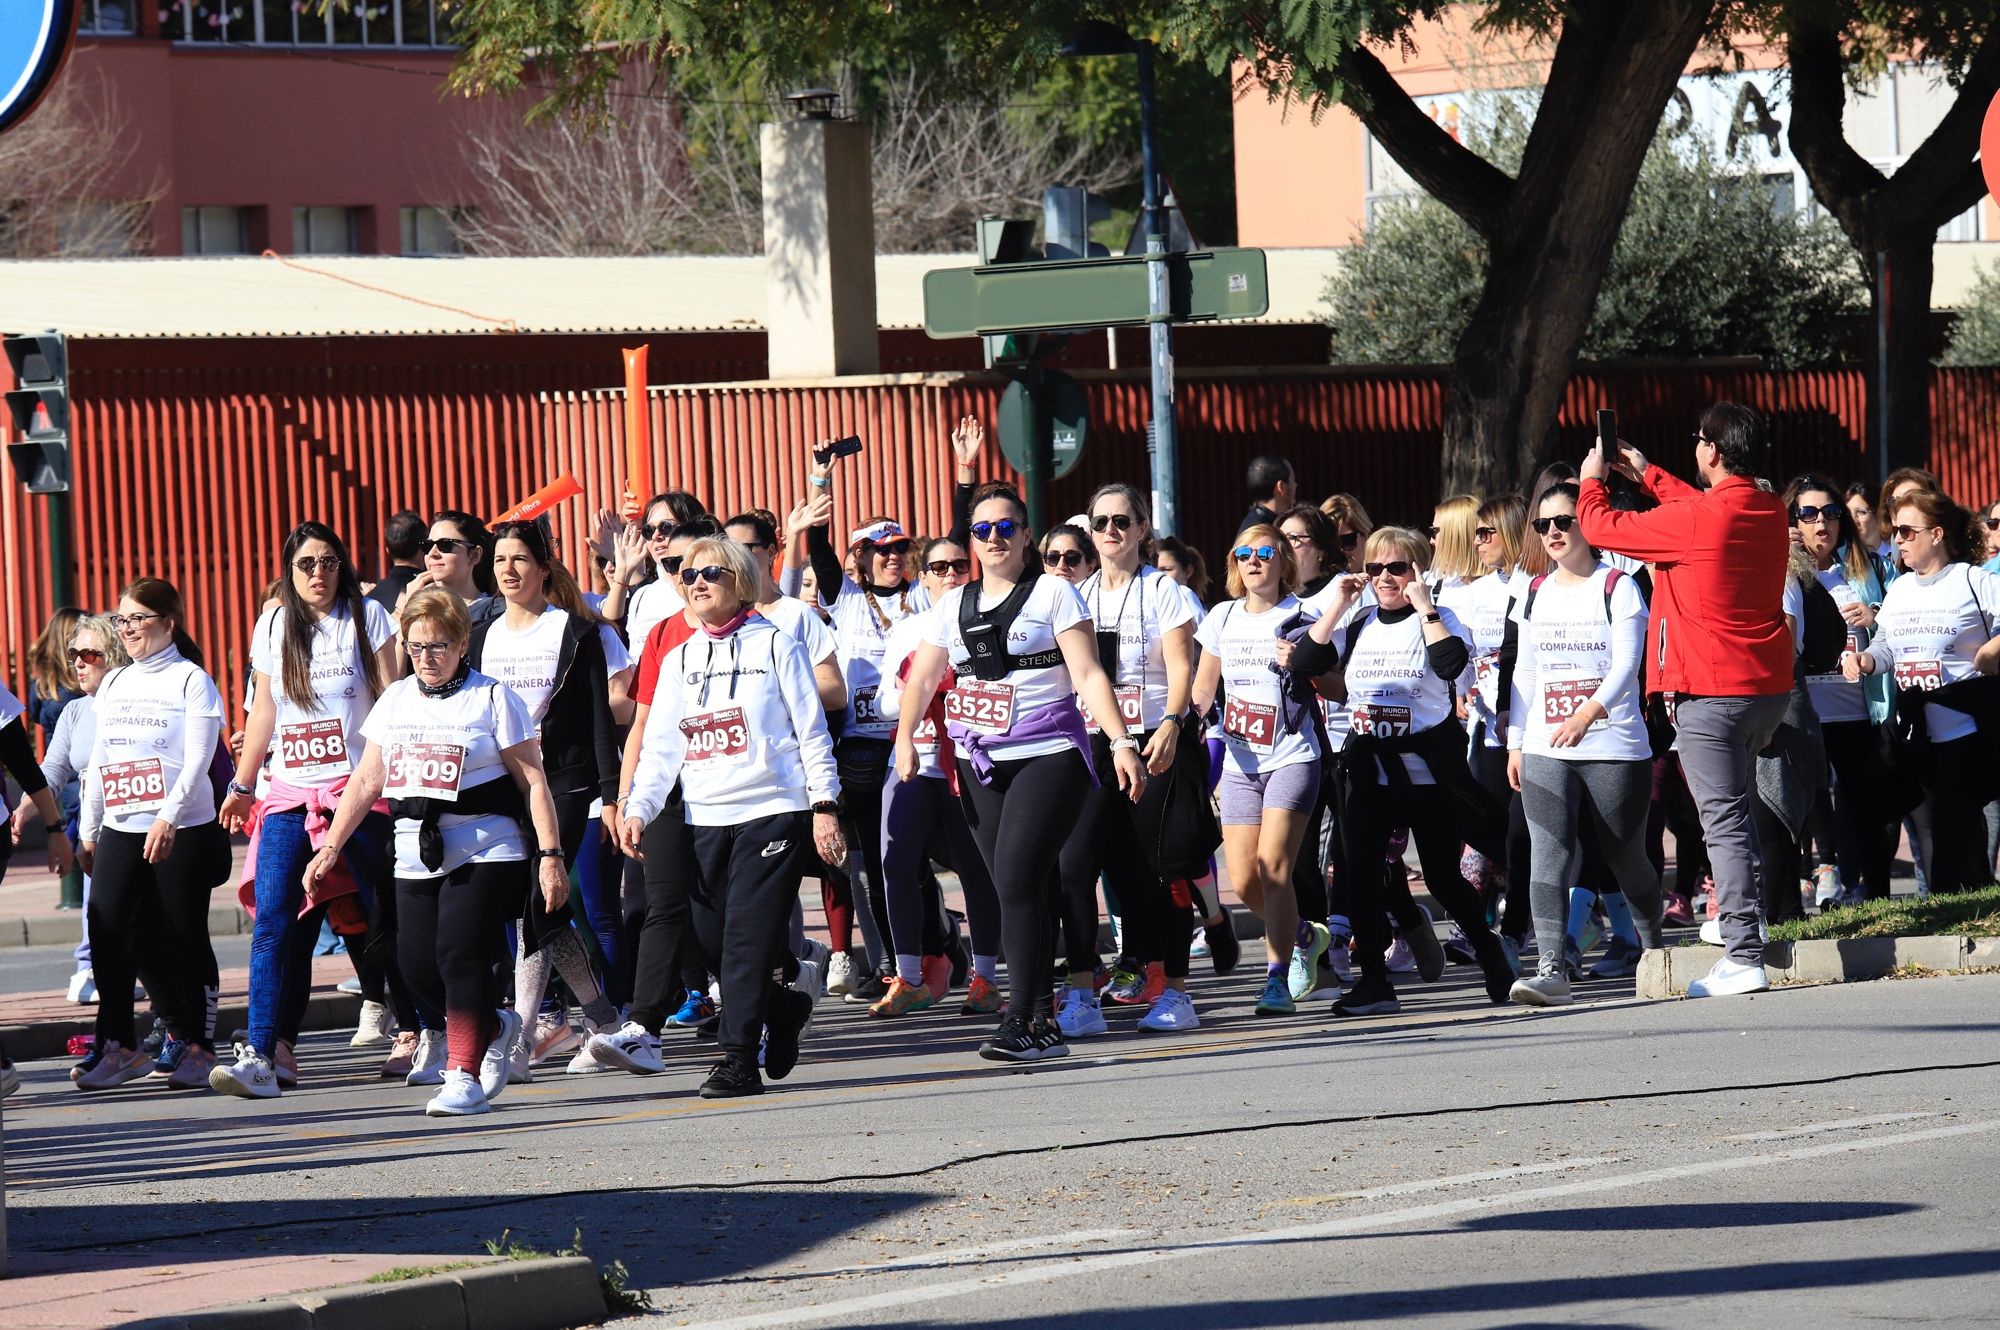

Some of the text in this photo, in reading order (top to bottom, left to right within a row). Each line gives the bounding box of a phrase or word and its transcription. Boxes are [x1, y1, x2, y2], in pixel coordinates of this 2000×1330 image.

[521, 499, 542, 514] fibra
[1480, 627, 1504, 637] COMP
[1893, 623, 1958, 637] COMPAÑERAS
[1121, 634, 1149, 645] ERAS
[1540, 640, 1607, 652] COMPAÑERAS
[525, 654, 543, 662] MUJER
[311, 666, 354, 681] AÑERAS
[1355, 667, 1425, 680] COMPAÑERAS
[984, 683, 1011, 693] MURCIA
[1577, 679, 1602, 688] MURCIA
[948, 693, 1010, 722] 3525
[1248, 703, 1275, 714] MURCIA
[1382, 707, 1409, 715] MURCIA
[1546, 694, 1589, 718] 332
[712, 709, 740, 721] MURCIA
[105, 714, 168, 729] COMPAÑERAS
[311, 720, 339, 730] MURCIA
[691, 718, 710, 730] mujer
[1228, 710, 1265, 738] 314
[456, 724, 472, 733] 2023
[688, 724, 748, 754] 4093
[283, 734, 344, 761] 2068
[431, 745, 460, 754] MURCIA
[134, 760, 160, 769] MURCIA
[101, 767, 109, 776] 8
[389, 758, 459, 784] 3609
[104, 773, 163, 801] 2508
[203, 984, 220, 1040] NIKE
